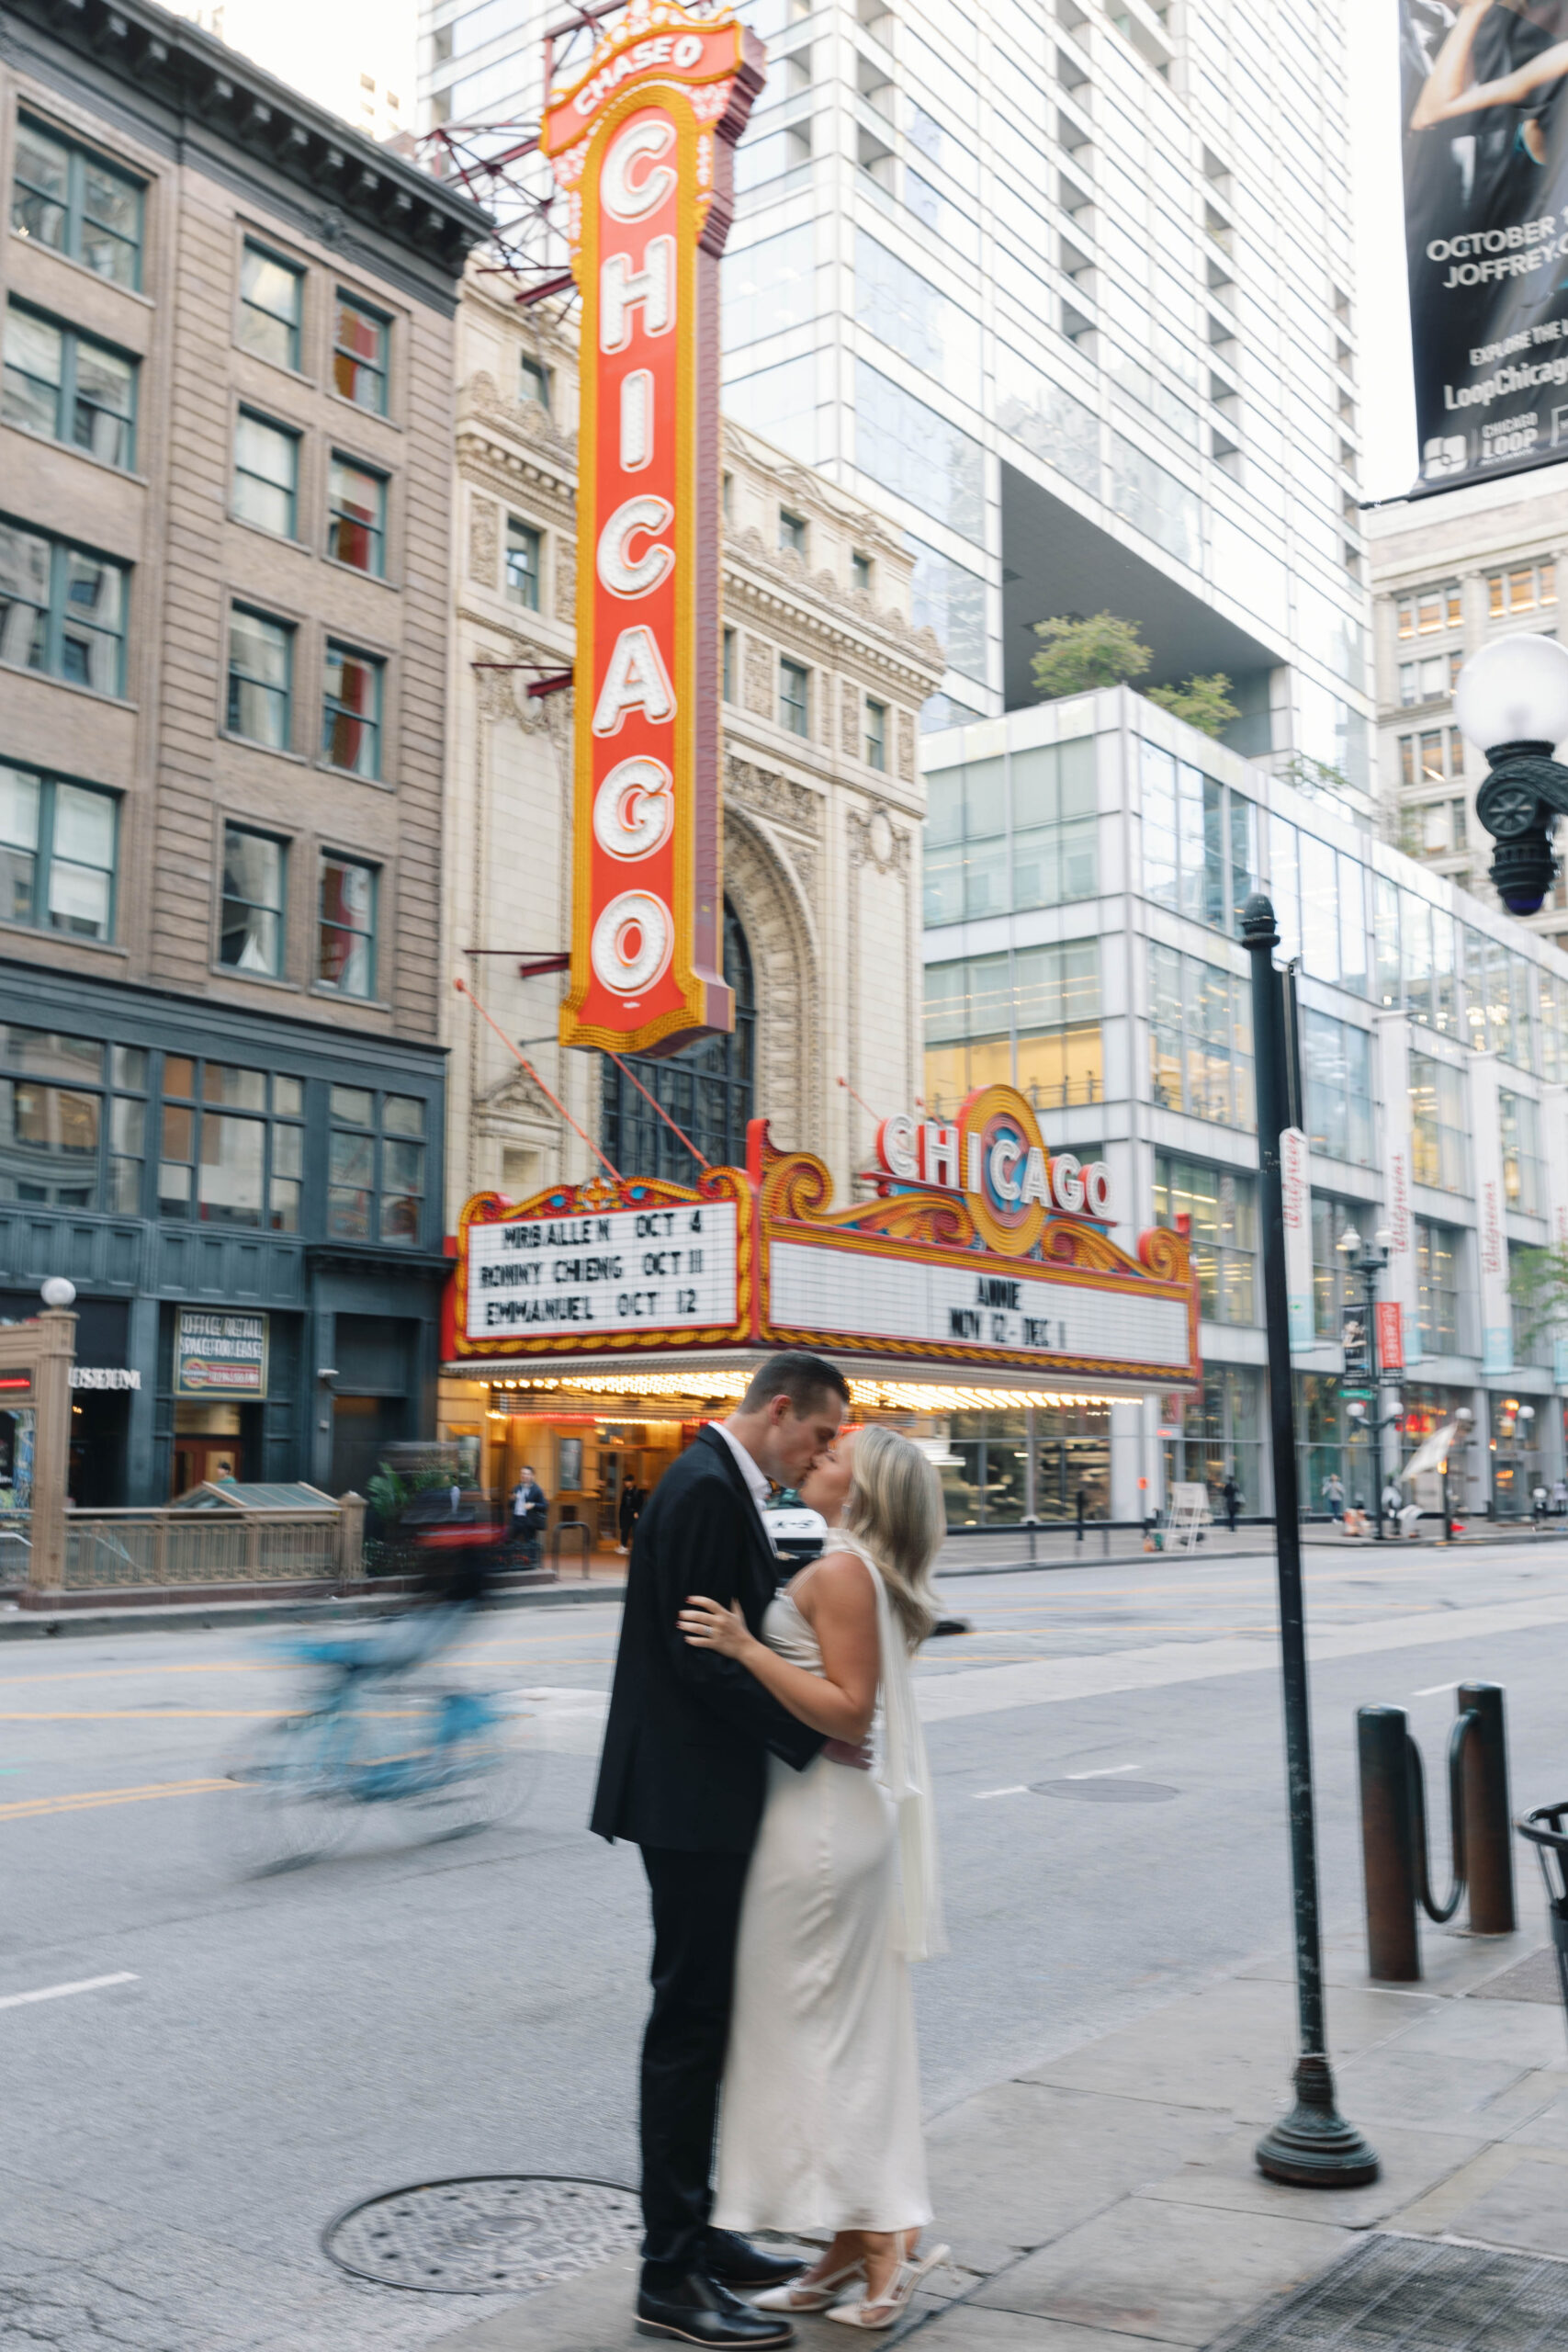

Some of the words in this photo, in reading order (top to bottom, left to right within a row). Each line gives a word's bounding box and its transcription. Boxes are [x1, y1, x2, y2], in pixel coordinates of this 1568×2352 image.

[573, 37, 674, 116] CHASE
[1426, 215, 1557, 262] OCTOBER
[1482, 427, 1539, 459] LOOP
[591, 119, 677, 997] CHICAGO
[878, 1114, 1113, 1218] CHICAGO
[635, 1213, 675, 1238] OCT
[689, 1209, 703, 1234] 4
[644, 1250, 682, 1276] OCT
[485, 1296, 593, 1326] EMMANUEL
[617, 1291, 659, 1317] OCT
[69, 1366, 141, 1390] USEUM
